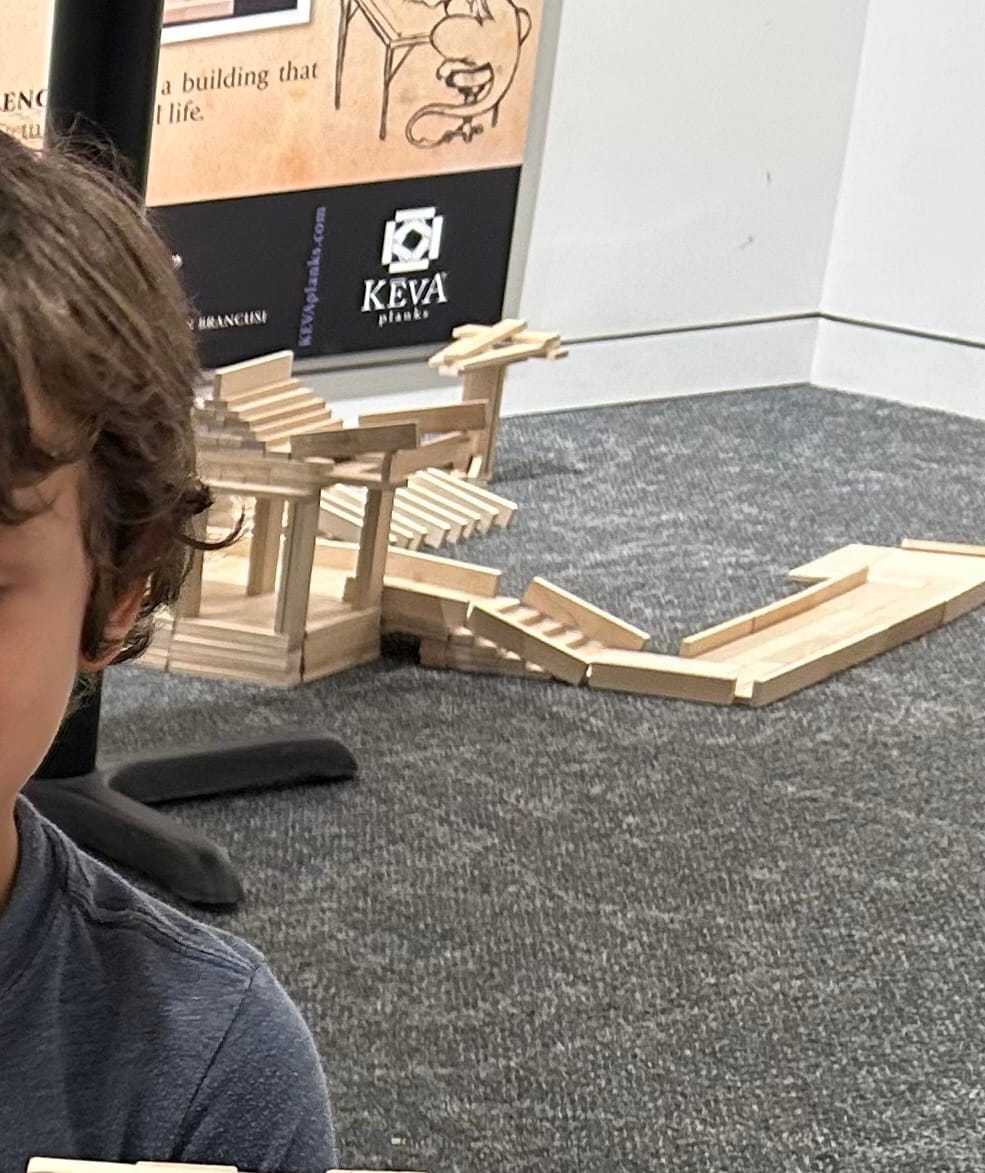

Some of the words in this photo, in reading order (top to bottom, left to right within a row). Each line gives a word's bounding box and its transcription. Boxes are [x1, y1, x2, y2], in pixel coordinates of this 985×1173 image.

[161, 80, 171, 96] a
[182, 66, 270, 94] building
[279, 60, 319, 83] that
[169, 100, 204, 124] life.
[298, 206, 327, 347] KEVAplanks.com
[198, 309, 267, 331] BRANCUSI
[378, 307, 429, 328] planks
